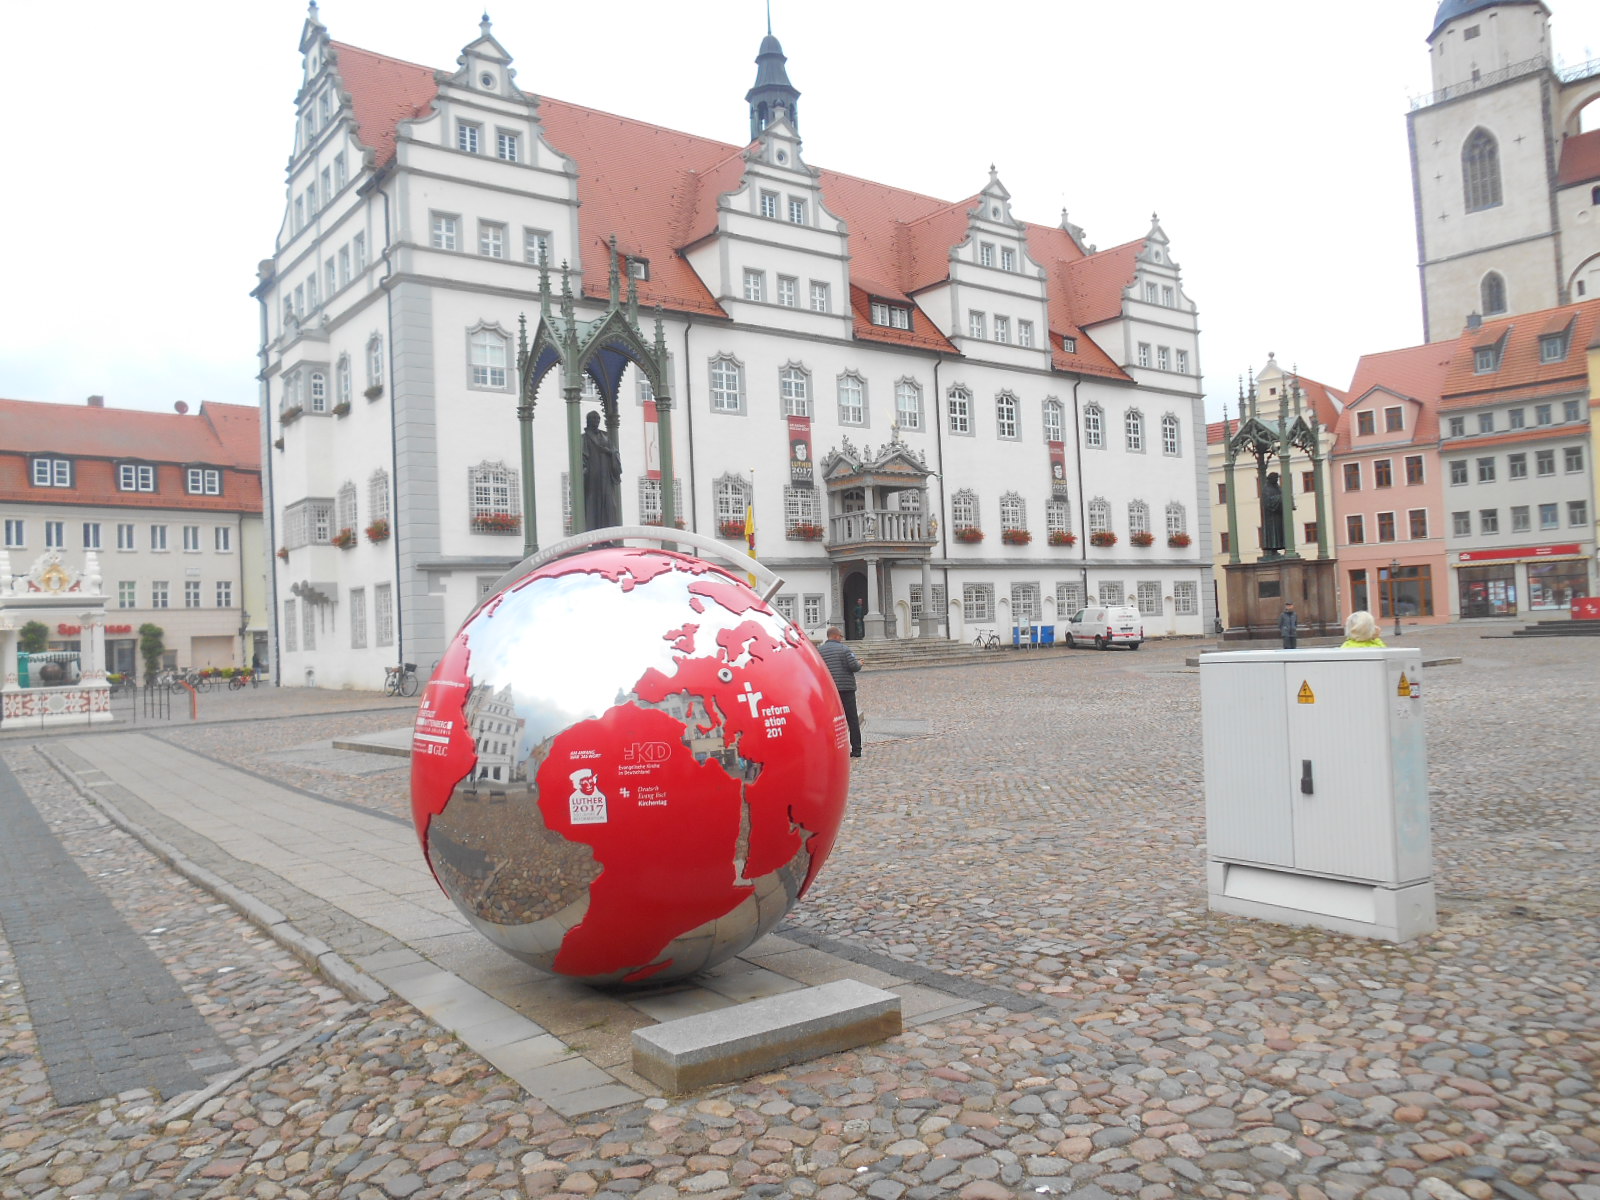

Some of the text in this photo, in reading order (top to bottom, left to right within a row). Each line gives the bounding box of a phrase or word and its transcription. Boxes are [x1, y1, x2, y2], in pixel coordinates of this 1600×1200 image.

[791, 467, 812, 477] 2017
[762, 705, 790, 717] reform
[764, 716, 787, 728] ation
[766, 727, 783, 738] 201
[572, 797, 603, 805] LUTHER
[638, 799, 668, 807] Kirchentag
[572, 805, 604, 816] 2017
